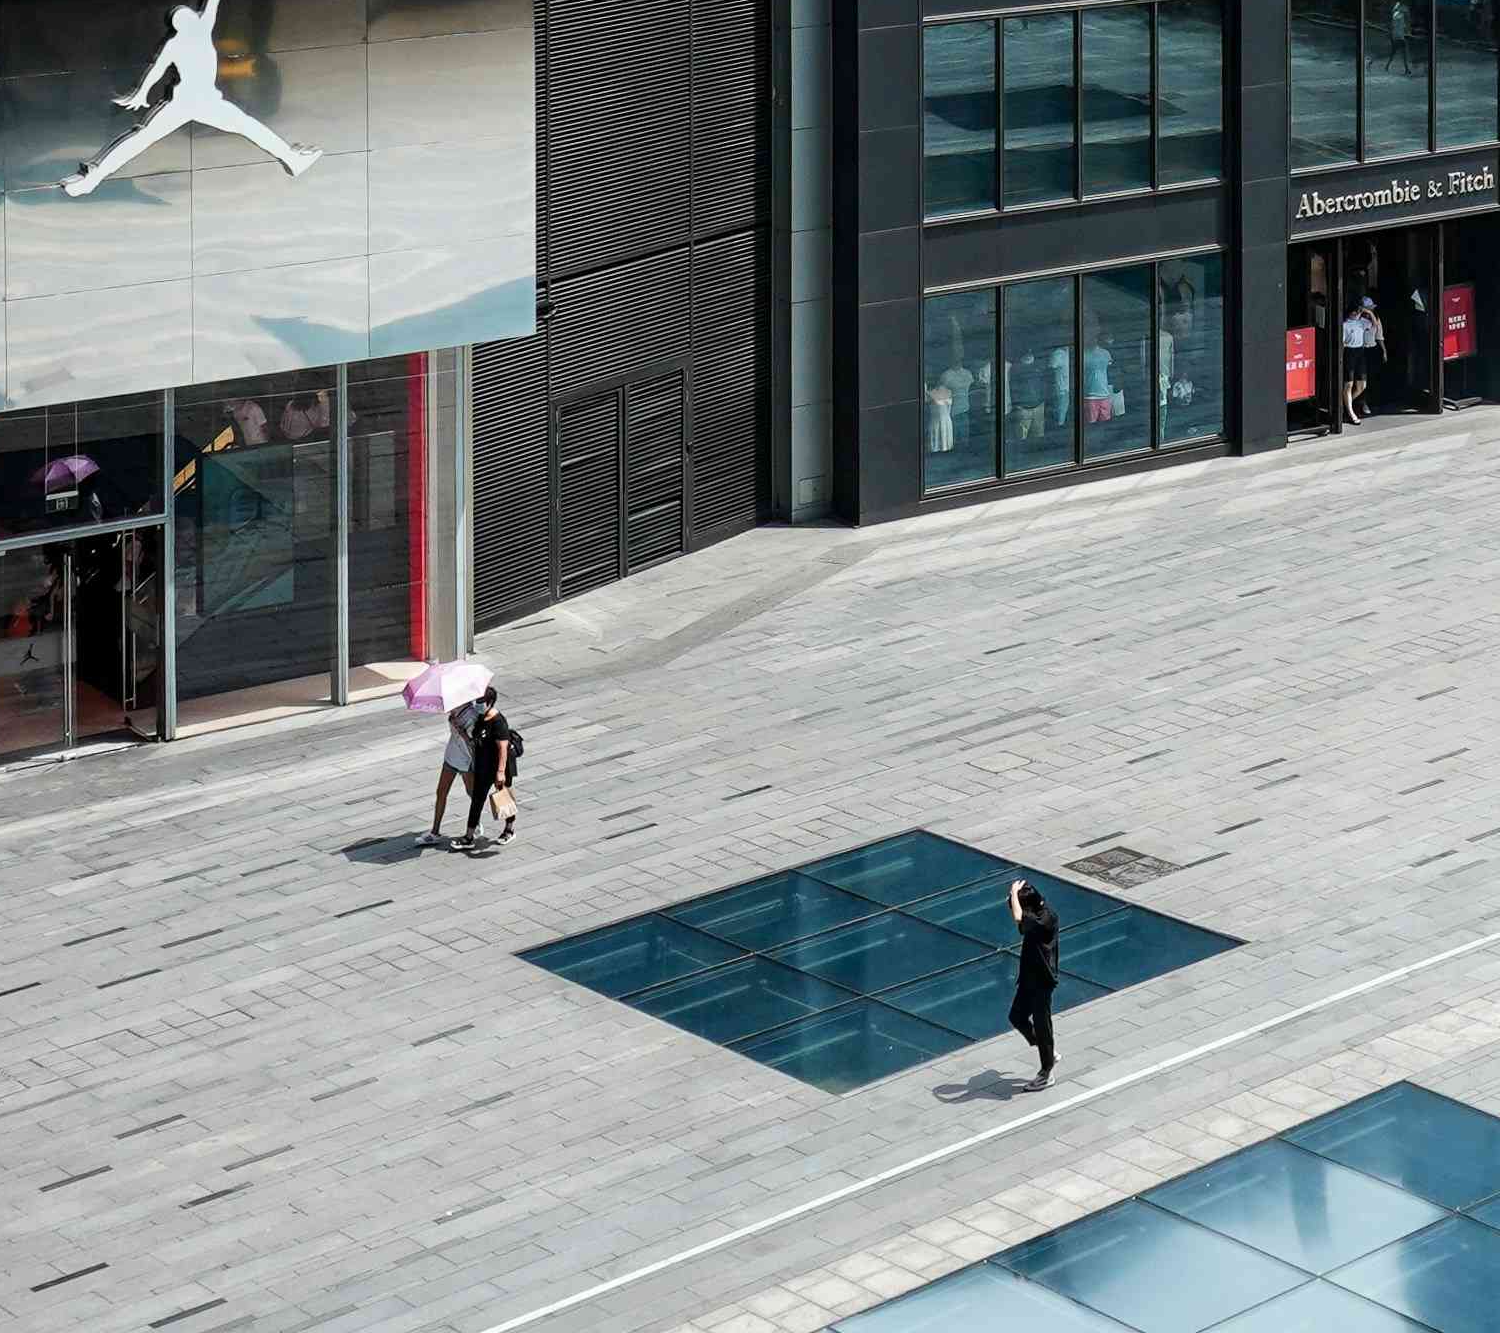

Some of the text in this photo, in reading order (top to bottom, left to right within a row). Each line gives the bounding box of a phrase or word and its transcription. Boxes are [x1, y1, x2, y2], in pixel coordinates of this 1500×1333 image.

[1295, 166, 1495, 219] Abercrombie & Fitch
